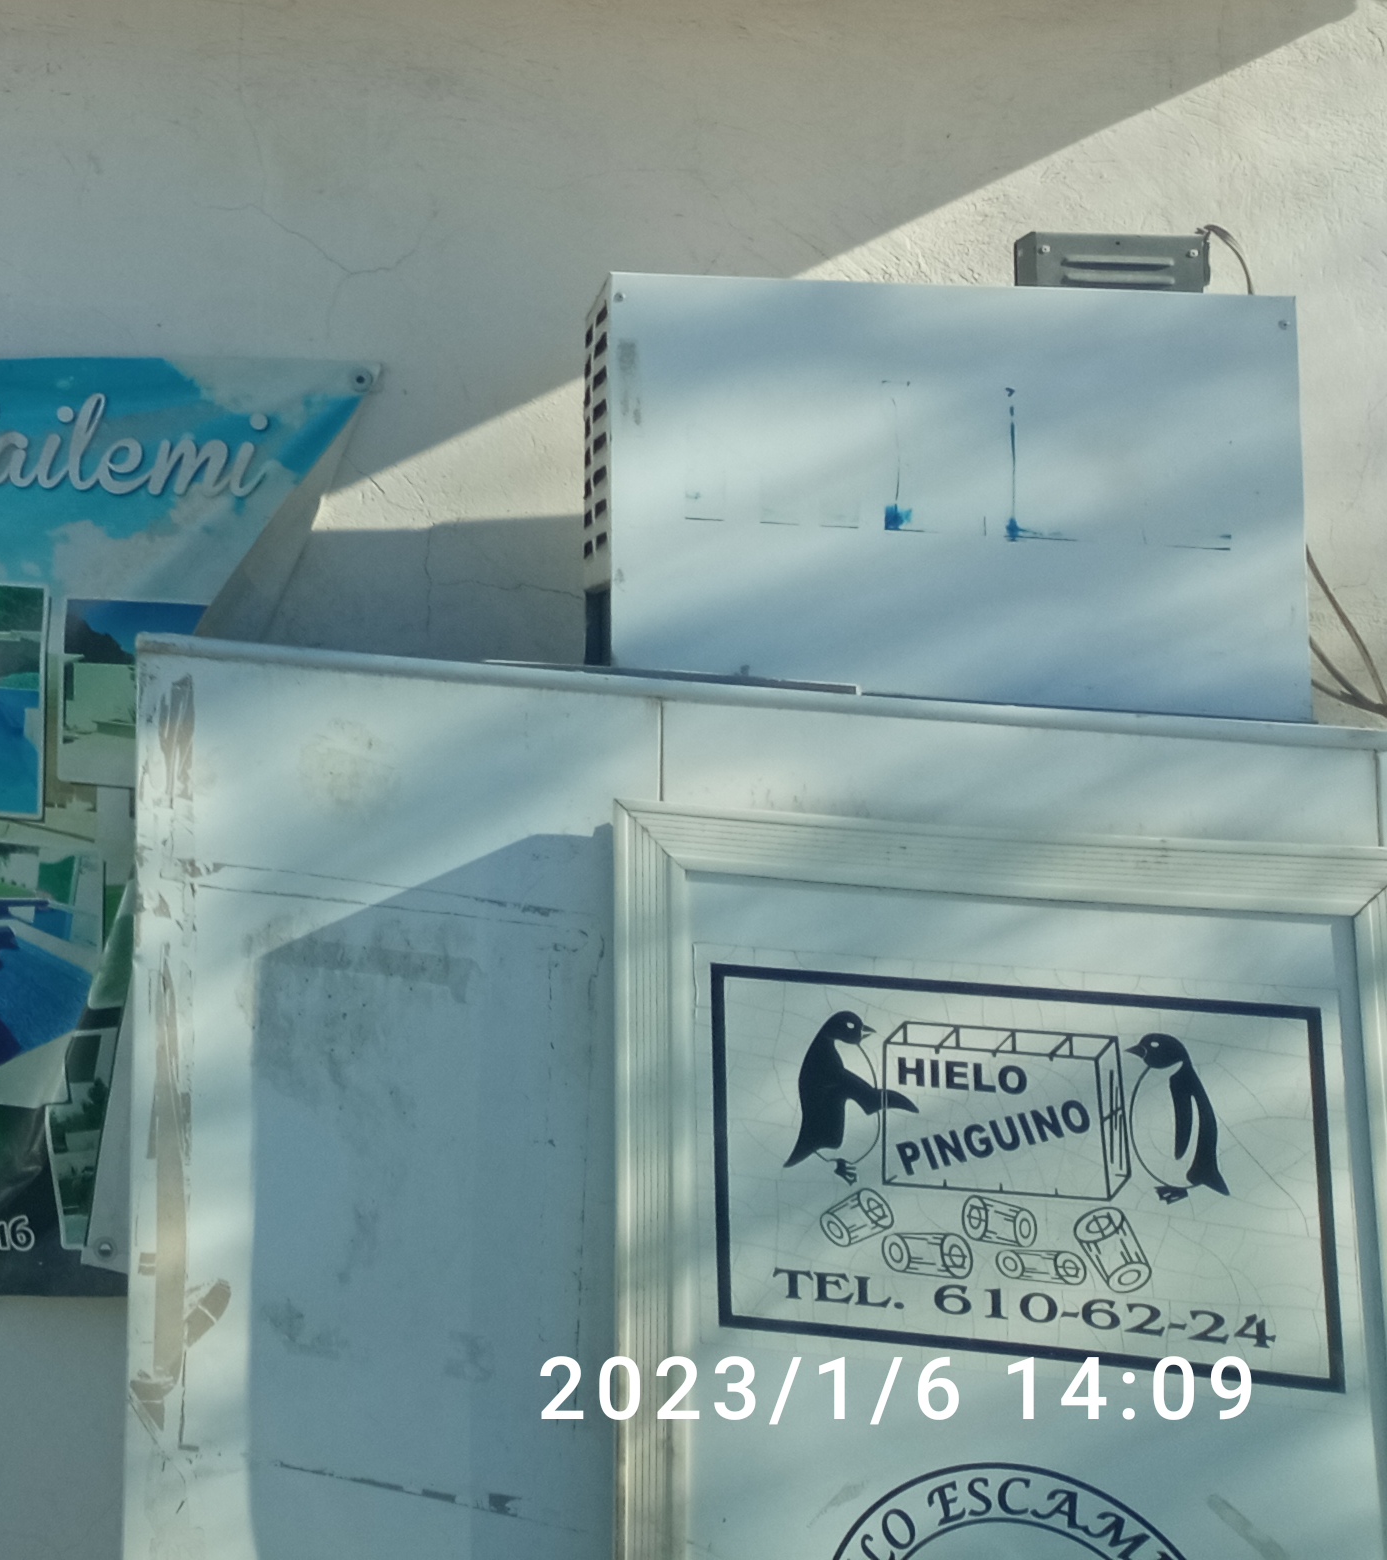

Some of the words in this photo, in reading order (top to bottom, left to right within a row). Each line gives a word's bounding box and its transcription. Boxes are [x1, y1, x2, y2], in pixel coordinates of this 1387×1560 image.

[897, 1057, 1028, 1095] HIELO
[895, 1099, 1091, 1176] PINGUINO
[772, 1267, 906, 1310] TEL.
[933, 1284, 1277, 1349] 610-62-24
[846, 1508, 916, 1560] LO
[927, 1477, 1175, 1560] ESCAM
